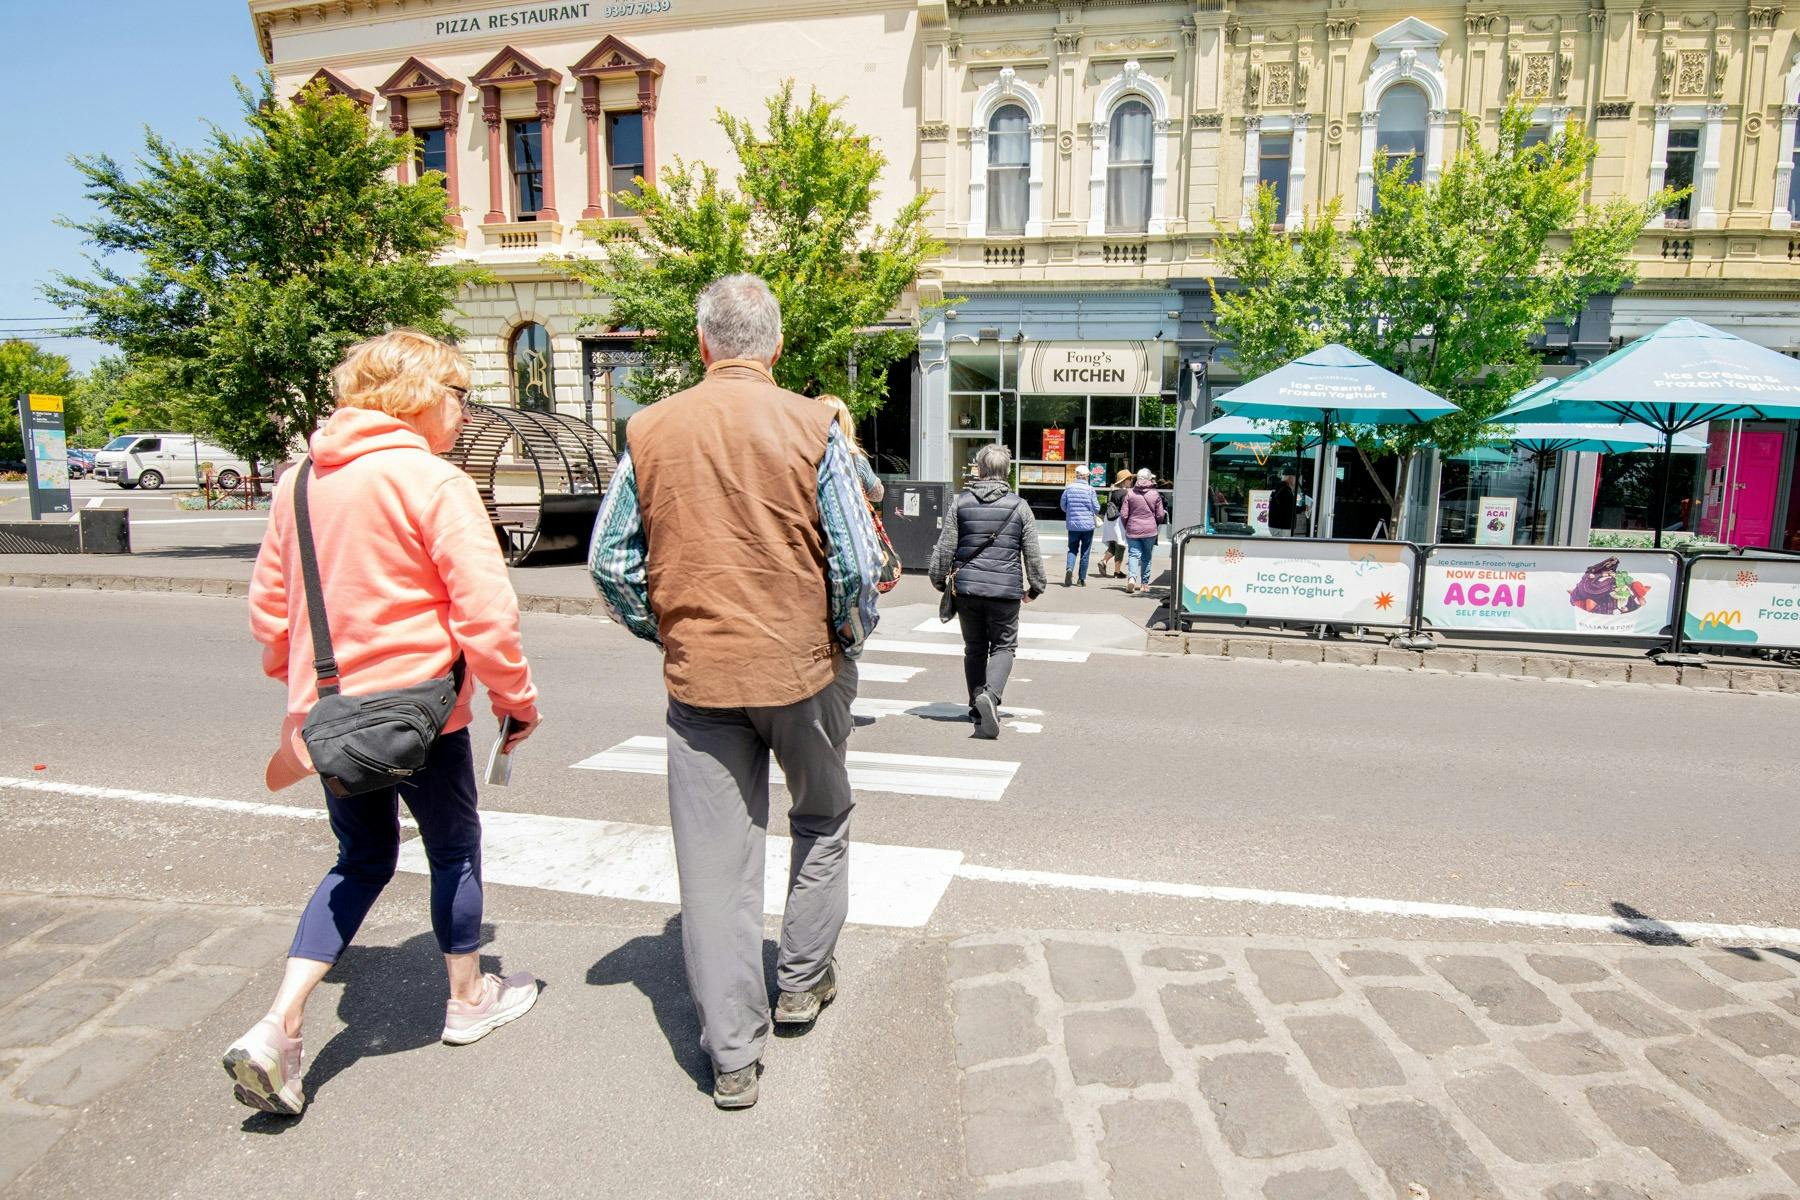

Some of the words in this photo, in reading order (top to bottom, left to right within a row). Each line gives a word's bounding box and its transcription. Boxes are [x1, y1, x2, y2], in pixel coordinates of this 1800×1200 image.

[436, 17, 481, 35] PIZZA
[488, 3, 590, 29] RESTAURANT
[1067, 351, 1112, 367] Fong's
[1053, 368, 1125, 382] KITCHEN
[1663, 371, 1693, 380] Ice
[1697, 371, 1761, 383] Cream
[1290, 381, 1312, 390] Ice
[1314, 383, 1361, 392] Cream
[1364, 384, 1375, 392] &
[1653, 380, 1722, 388] Frozen
[1279, 387, 1326, 398] Frozen
[1328, 390, 1388, 400] Yoghurt
[1486, 510, 1508, 518] ACAI
[1507, 561, 1536, 569] Yoghurt
[1256, 571, 1276, 582] Ice
[1279, 572, 1322, 584] Cream
[1324, 574, 1335, 585] &
[1446, 570, 1475, 579] NOW
[1477, 570, 1527, 581] SELLING
[1246, 583, 1289, 595] Frozen
[1291, 585, 1345, 599] Yoghurt
[1443, 582, 1526, 608] ACAI
[1771, 595, 1793, 607] Ice
[1455, 609, 1477, 617] SELF
[1758, 608, 1800, 621] Froze
